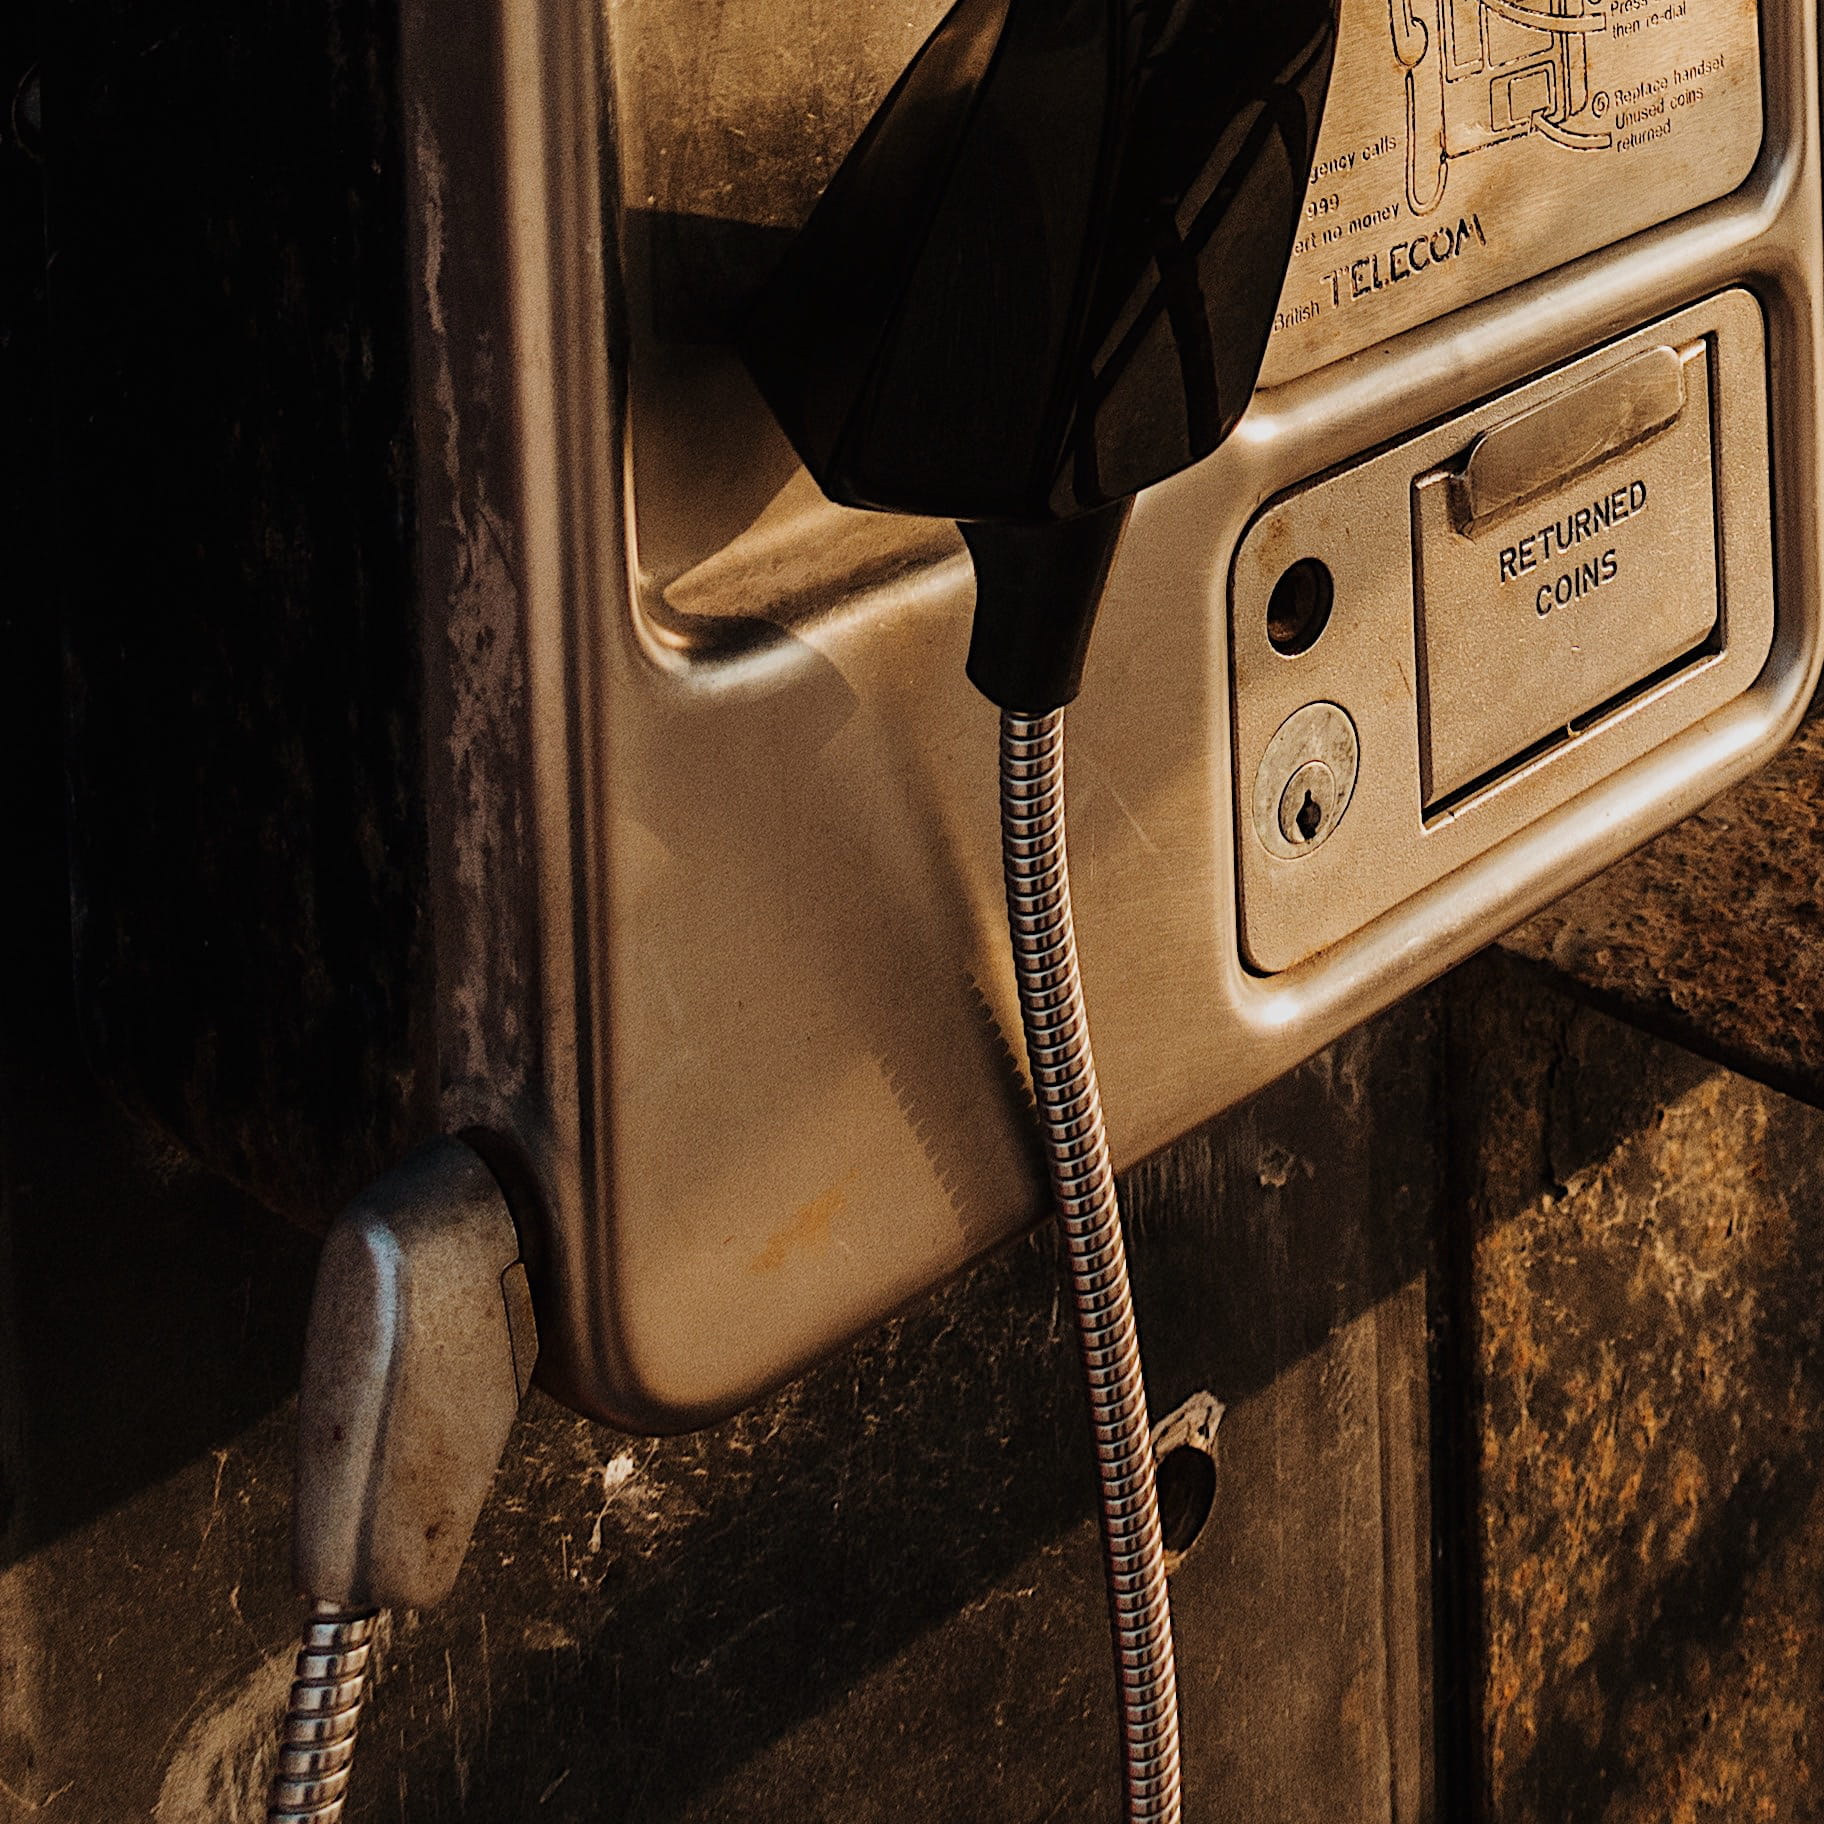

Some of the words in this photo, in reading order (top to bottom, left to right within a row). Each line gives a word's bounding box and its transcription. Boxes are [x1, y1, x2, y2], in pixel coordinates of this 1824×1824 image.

[1613, 20, 1640, 40] then
[1646, 1, 1687, 28] re-dial
[1614, 75, 1668, 107] Replace
[1673, 54, 1725, 85] handset
[1615, 98, 1664, 130] Unused
[1670, 87, 1704, 110] coins
[1310, 152, 1355, 184] gency
[1362, 135, 1397, 161] calls
[1616, 118, 1671, 152] returned
[1295, 232, 1317, 256] ert
[1322, 227, 1342, 244] no
[1349, 202, 1400, 234] money
[1306, 193, 1340, 219] 999
[1274, 301, 1320, 332] British
[1322, 213, 1487, 308] TELECOM
[1500, 480, 1647, 583] RETURNED
[1536, 549, 1618, 616] COINS
